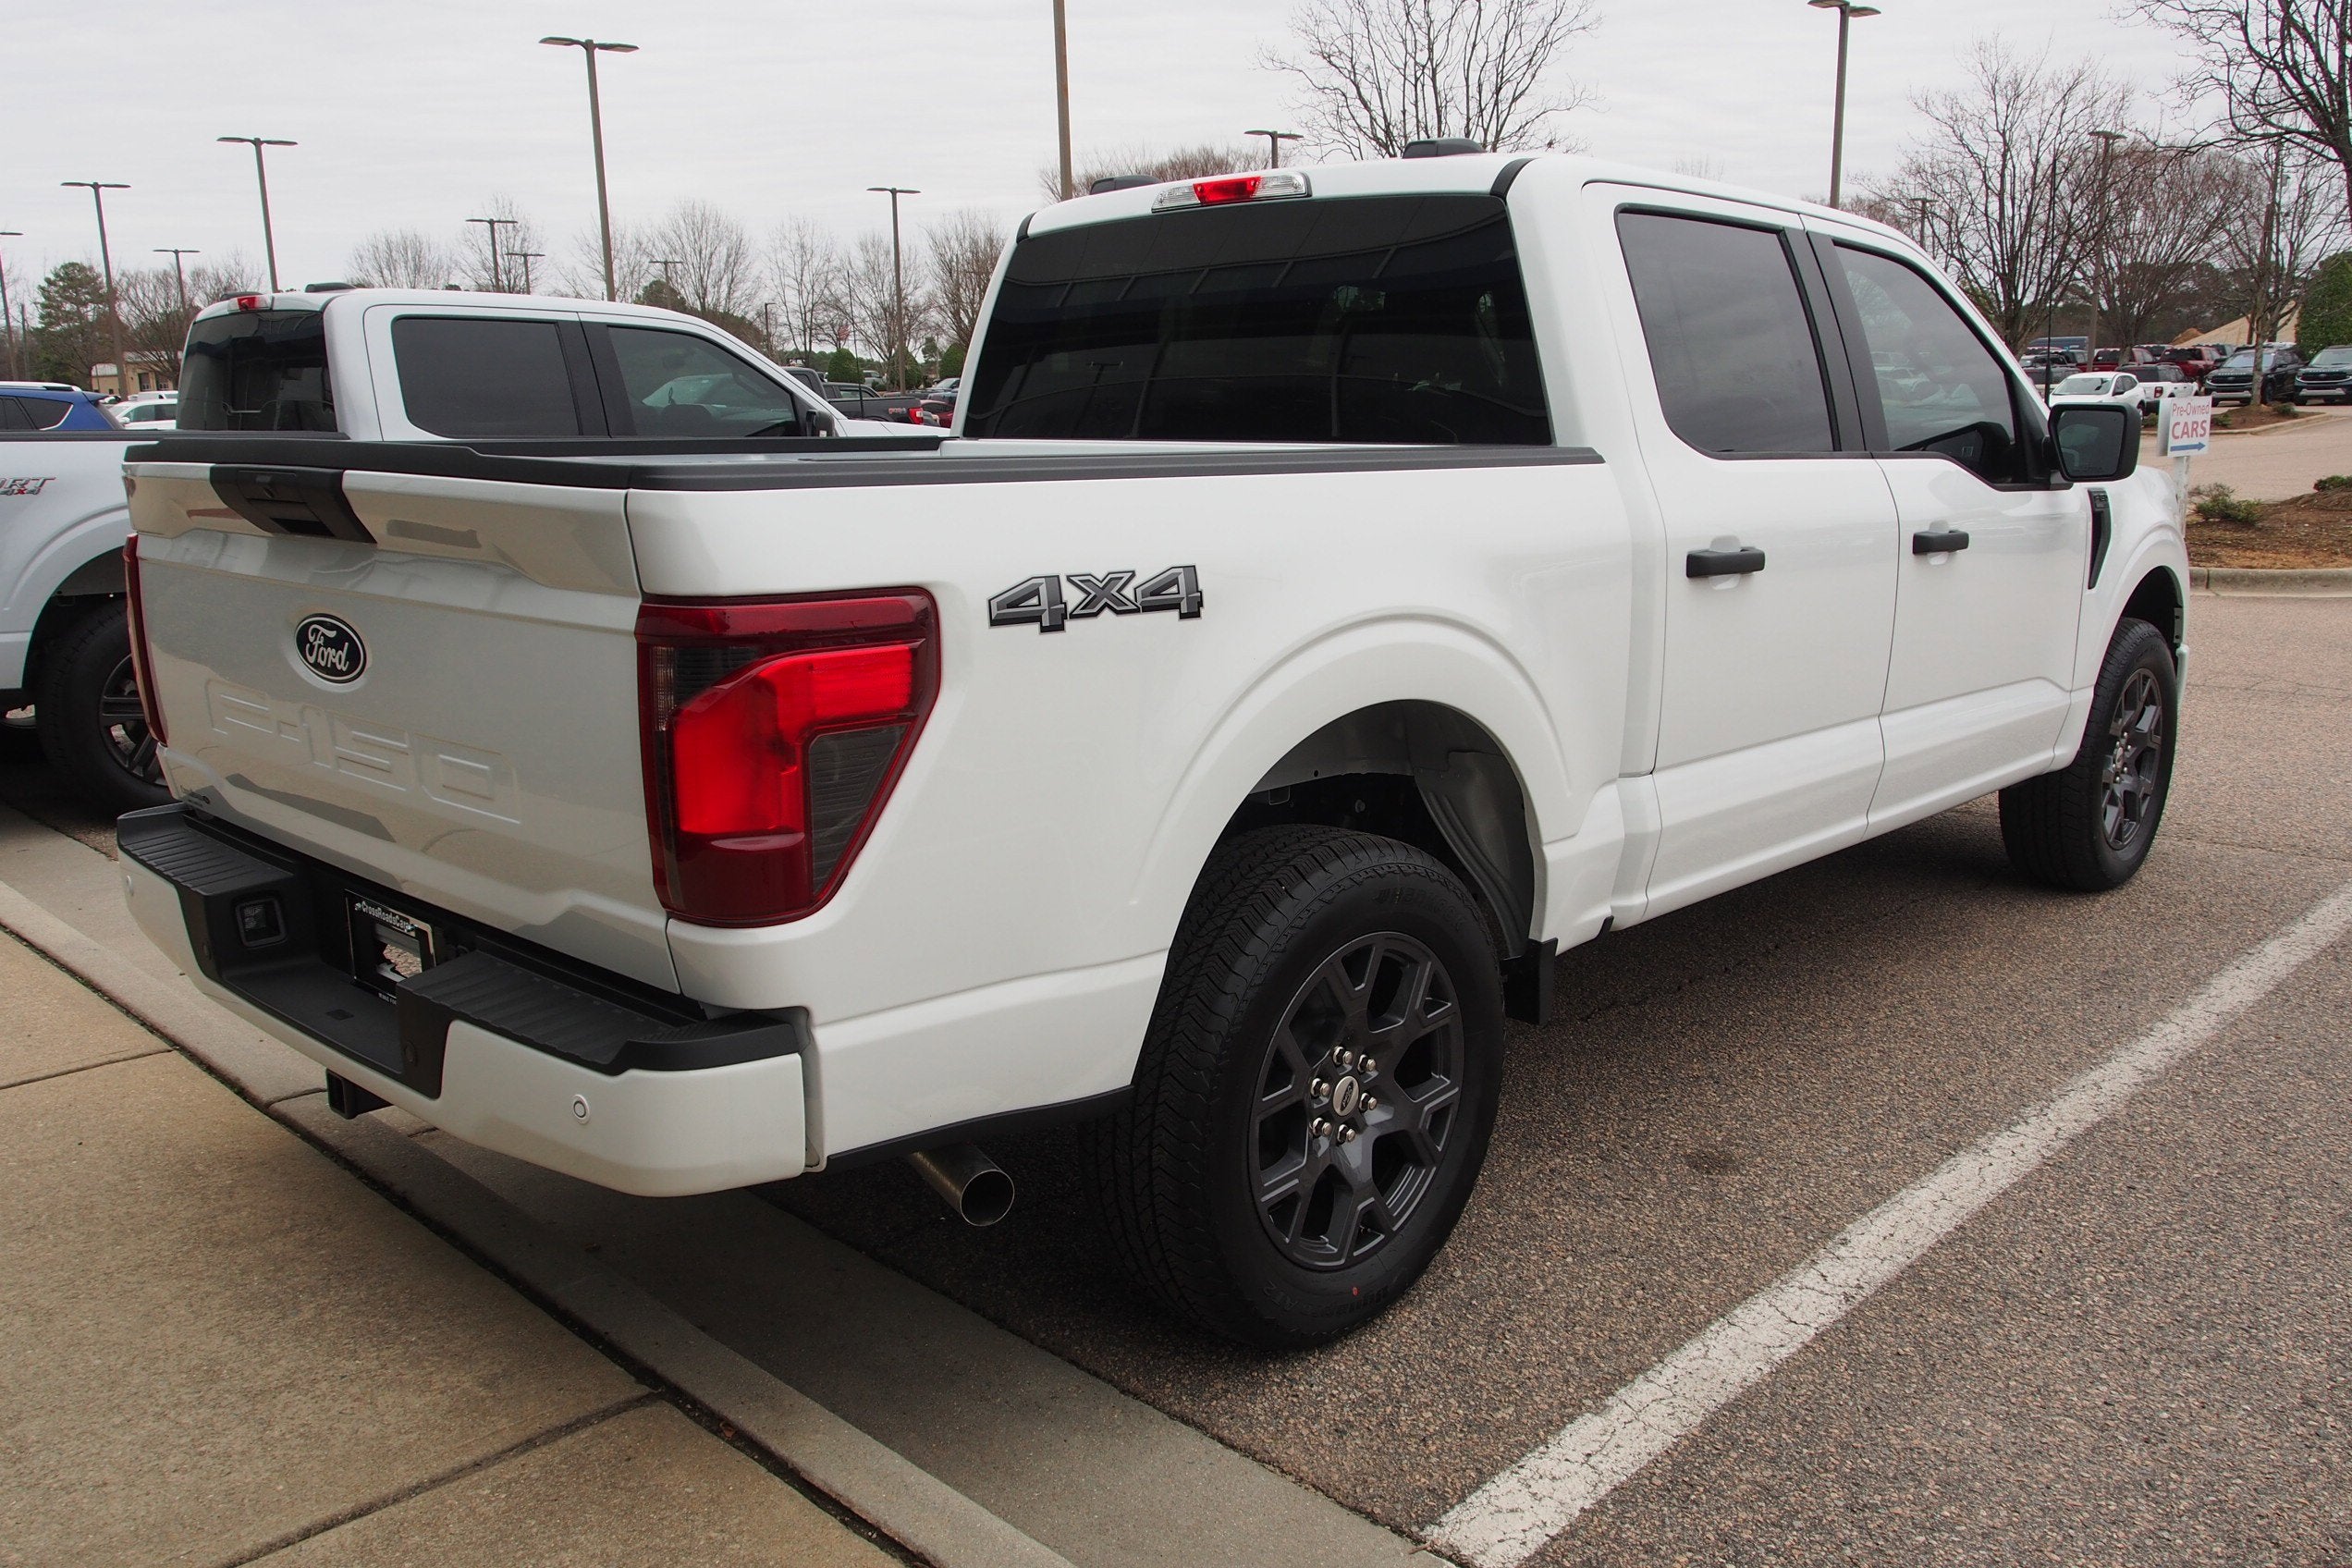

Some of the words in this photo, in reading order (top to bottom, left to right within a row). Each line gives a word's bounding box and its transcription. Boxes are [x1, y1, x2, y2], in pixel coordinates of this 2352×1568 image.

[2173, 400, 2210, 416] Pre-Owned
[2172, 420, 2208, 440] CARS
[305, 623, 349, 672] Ford
[203, 677, 521, 825] F-150
